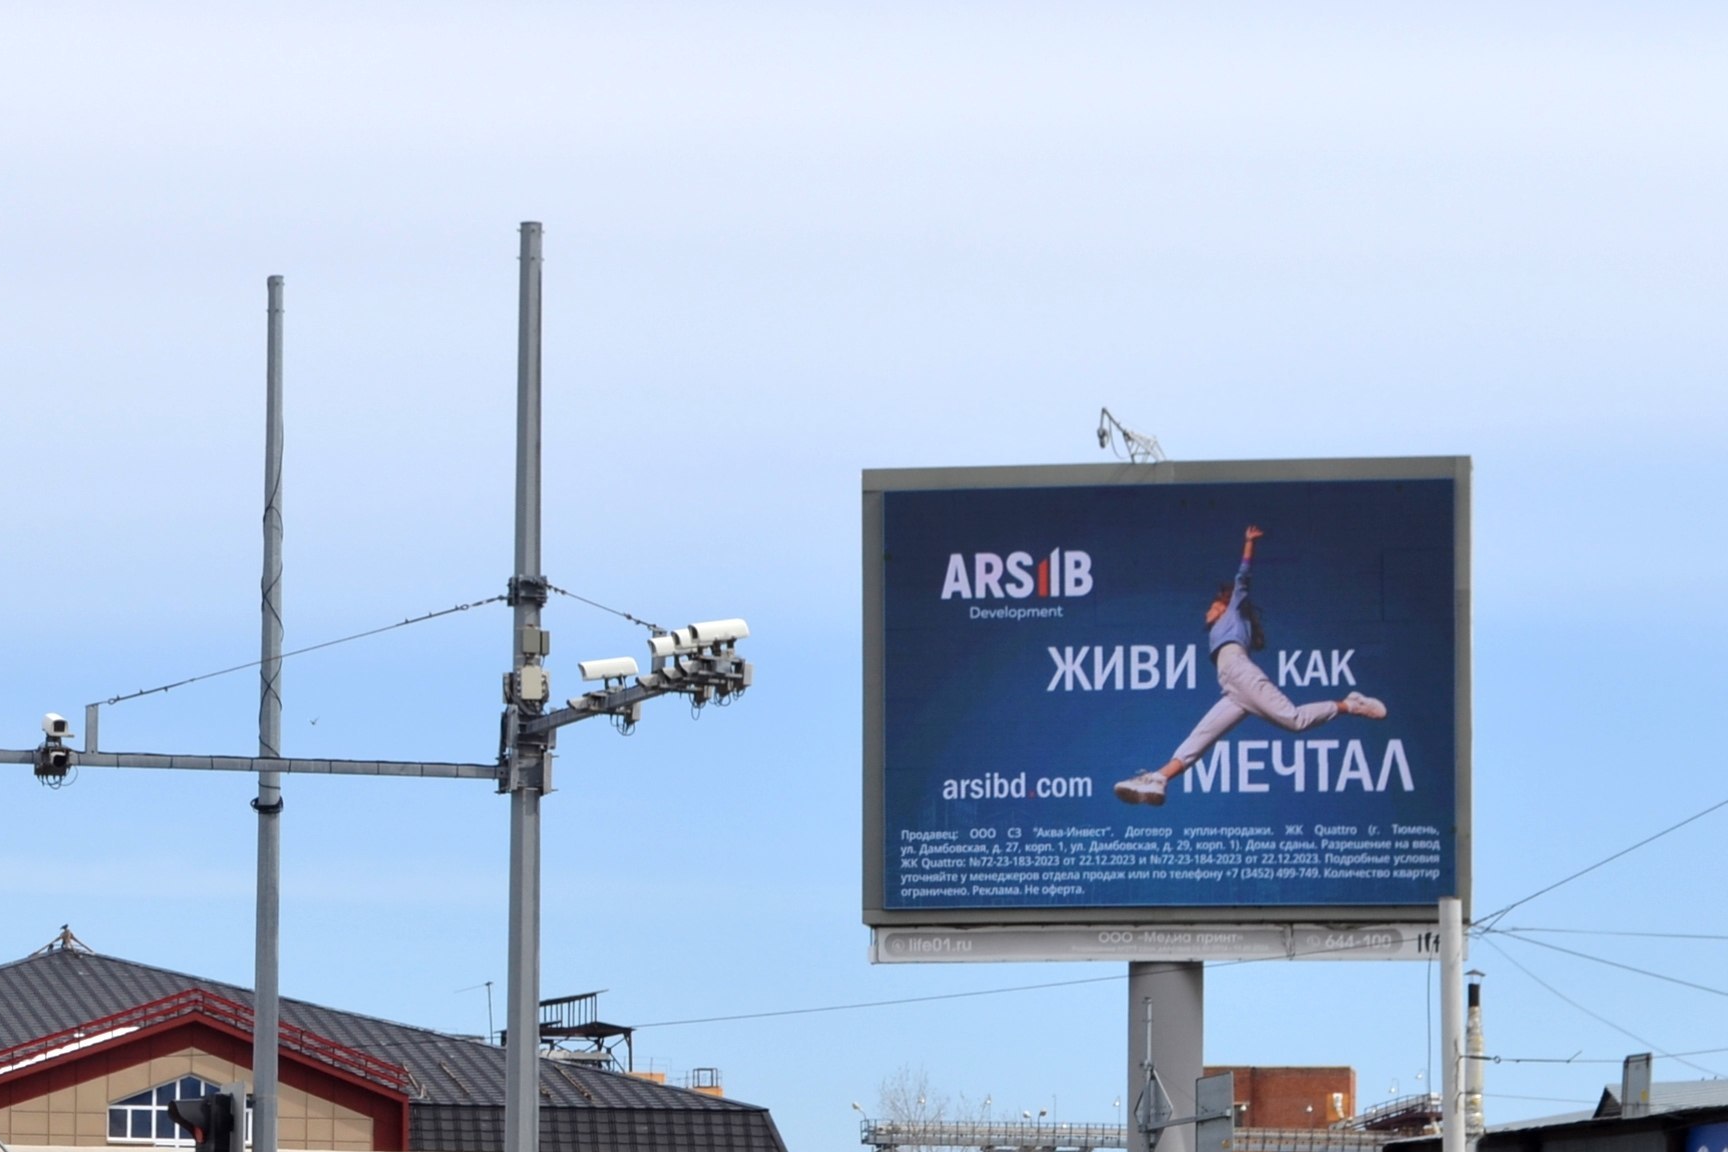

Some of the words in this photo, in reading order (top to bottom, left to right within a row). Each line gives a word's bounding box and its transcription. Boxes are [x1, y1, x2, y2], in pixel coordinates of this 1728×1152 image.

[969, 605, 1064, 621] Development
[1047, 644, 1196, 691] ЖИВИ
[1278, 648, 1357, 687] КАК
[1183, 739, 1415, 793] МЕЧТАЛ
[942, 772, 1093, 800] arsibd.com
[900, 828, 959, 842] Продавец:
[969, 828, 997, 839] ООО
[1006, 828, 1023, 839] СЗ
[1124, 826, 1173, 840] Договор
[1284, 825, 1304, 836] ЖК
[1313, 825, 1358, 838] Quattro
[1391, 824, 1440, 837] Тюмень,
[899, 845, 917, 857] ул.
[918, 843, 990, 857] Дамбовская,
[991, 845, 1003, 856] д.
[1005, 843, 1022, 856] 27,
[1024, 844, 1056, 856] корп.
[1057, 843, 1068, 856] 1,
[1070, 844, 1087, 856] ул.
[1088, 842, 1160, 855] Дамбовская,
[1162, 844, 1174, 855] д.
[1176, 842, 1193, 855] 29,
[1195, 843, 1227, 855] корп.
[1228, 841, 1243, 854] 1).
[1244, 841, 1277, 854] Дома
[1278, 843, 1319, 854] сданы.
[1320, 840, 1392, 854] Разрешение
[1394, 842, 1410, 851] на
[1411, 842, 1441, 853] ввод
[899, 858, 919, 868] ЖК
[920, 857, 966, 871] Quattro:
[1062, 858, 1076, 867] от
[1078, 856, 1136, 867] 22.12.2023
[1138, 858, 1147, 867] и
[1244, 857, 1259, 866] от
[1260, 855, 1322, 866] 22.12.2023.
[1324, 854, 1391, 868] Подробные
[1392, 856, 1441, 867] условия
[899, 871, 959, 885] уточняйте
[959, 873, 968, 884] у
[969, 873, 1040, 884] менеджеров
[1041, 872, 1081, 884] отдела
[1082, 872, 1126, 883] продаж
[1127, 872, 1151, 881] или
[1152, 872, 1168, 880] по
[1169, 869, 1224, 883] телефону
[1224, 869, 1239, 880] +7
[1240, 869, 1274, 882] (3452)
[1275, 869, 1322, 880] 499-749.
[1323, 868, 1391, 879] Количество
[1392, 870, 1441, 881] квартир
[899, 887, 971, 899] ограничено.
[971, 885, 1023, 896] Реклама.
[1023, 885, 1040, 896] Не
[1041, 885, 1085, 898] оферта.
[909, 938, 972, 953] life01.ru
[1098, 932, 1133, 944] ООО
[1325, 934, 1392, 948] 644-100
